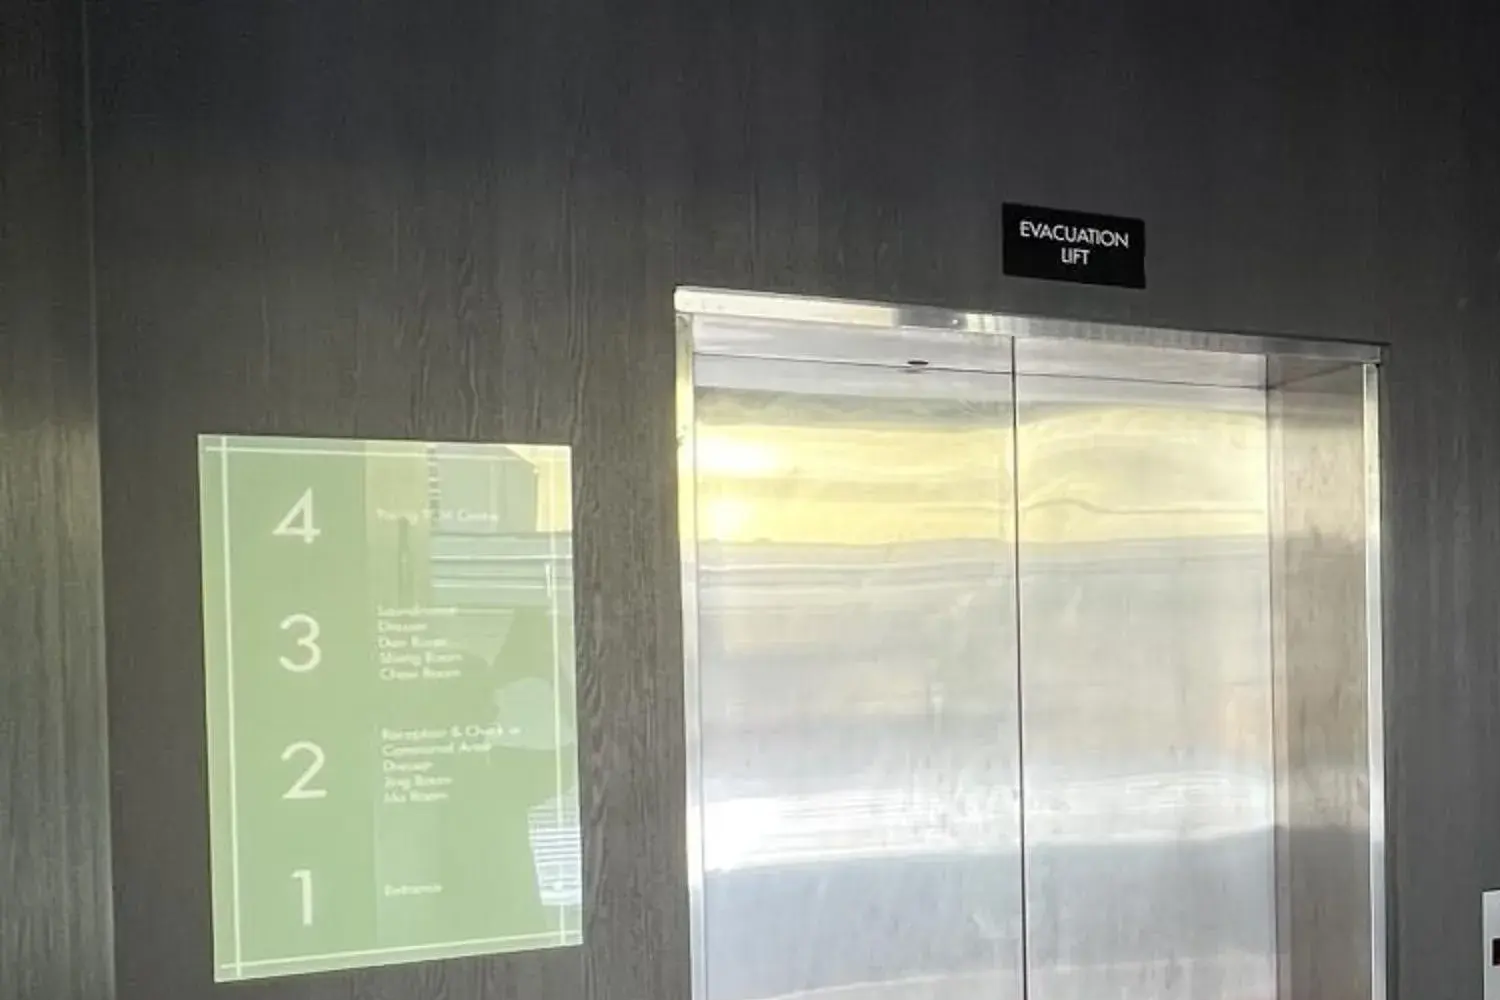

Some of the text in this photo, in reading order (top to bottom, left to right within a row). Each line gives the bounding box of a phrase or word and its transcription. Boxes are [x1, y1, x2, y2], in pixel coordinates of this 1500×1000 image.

[1019, 220, 1129, 248] EVACUATION
[1061, 247, 1090, 265] LIFT
[272, 487, 322, 544] 4
[278, 614, 322, 672] 3
[280, 740, 328, 799] 2
[290, 869, 314, 926] 1
